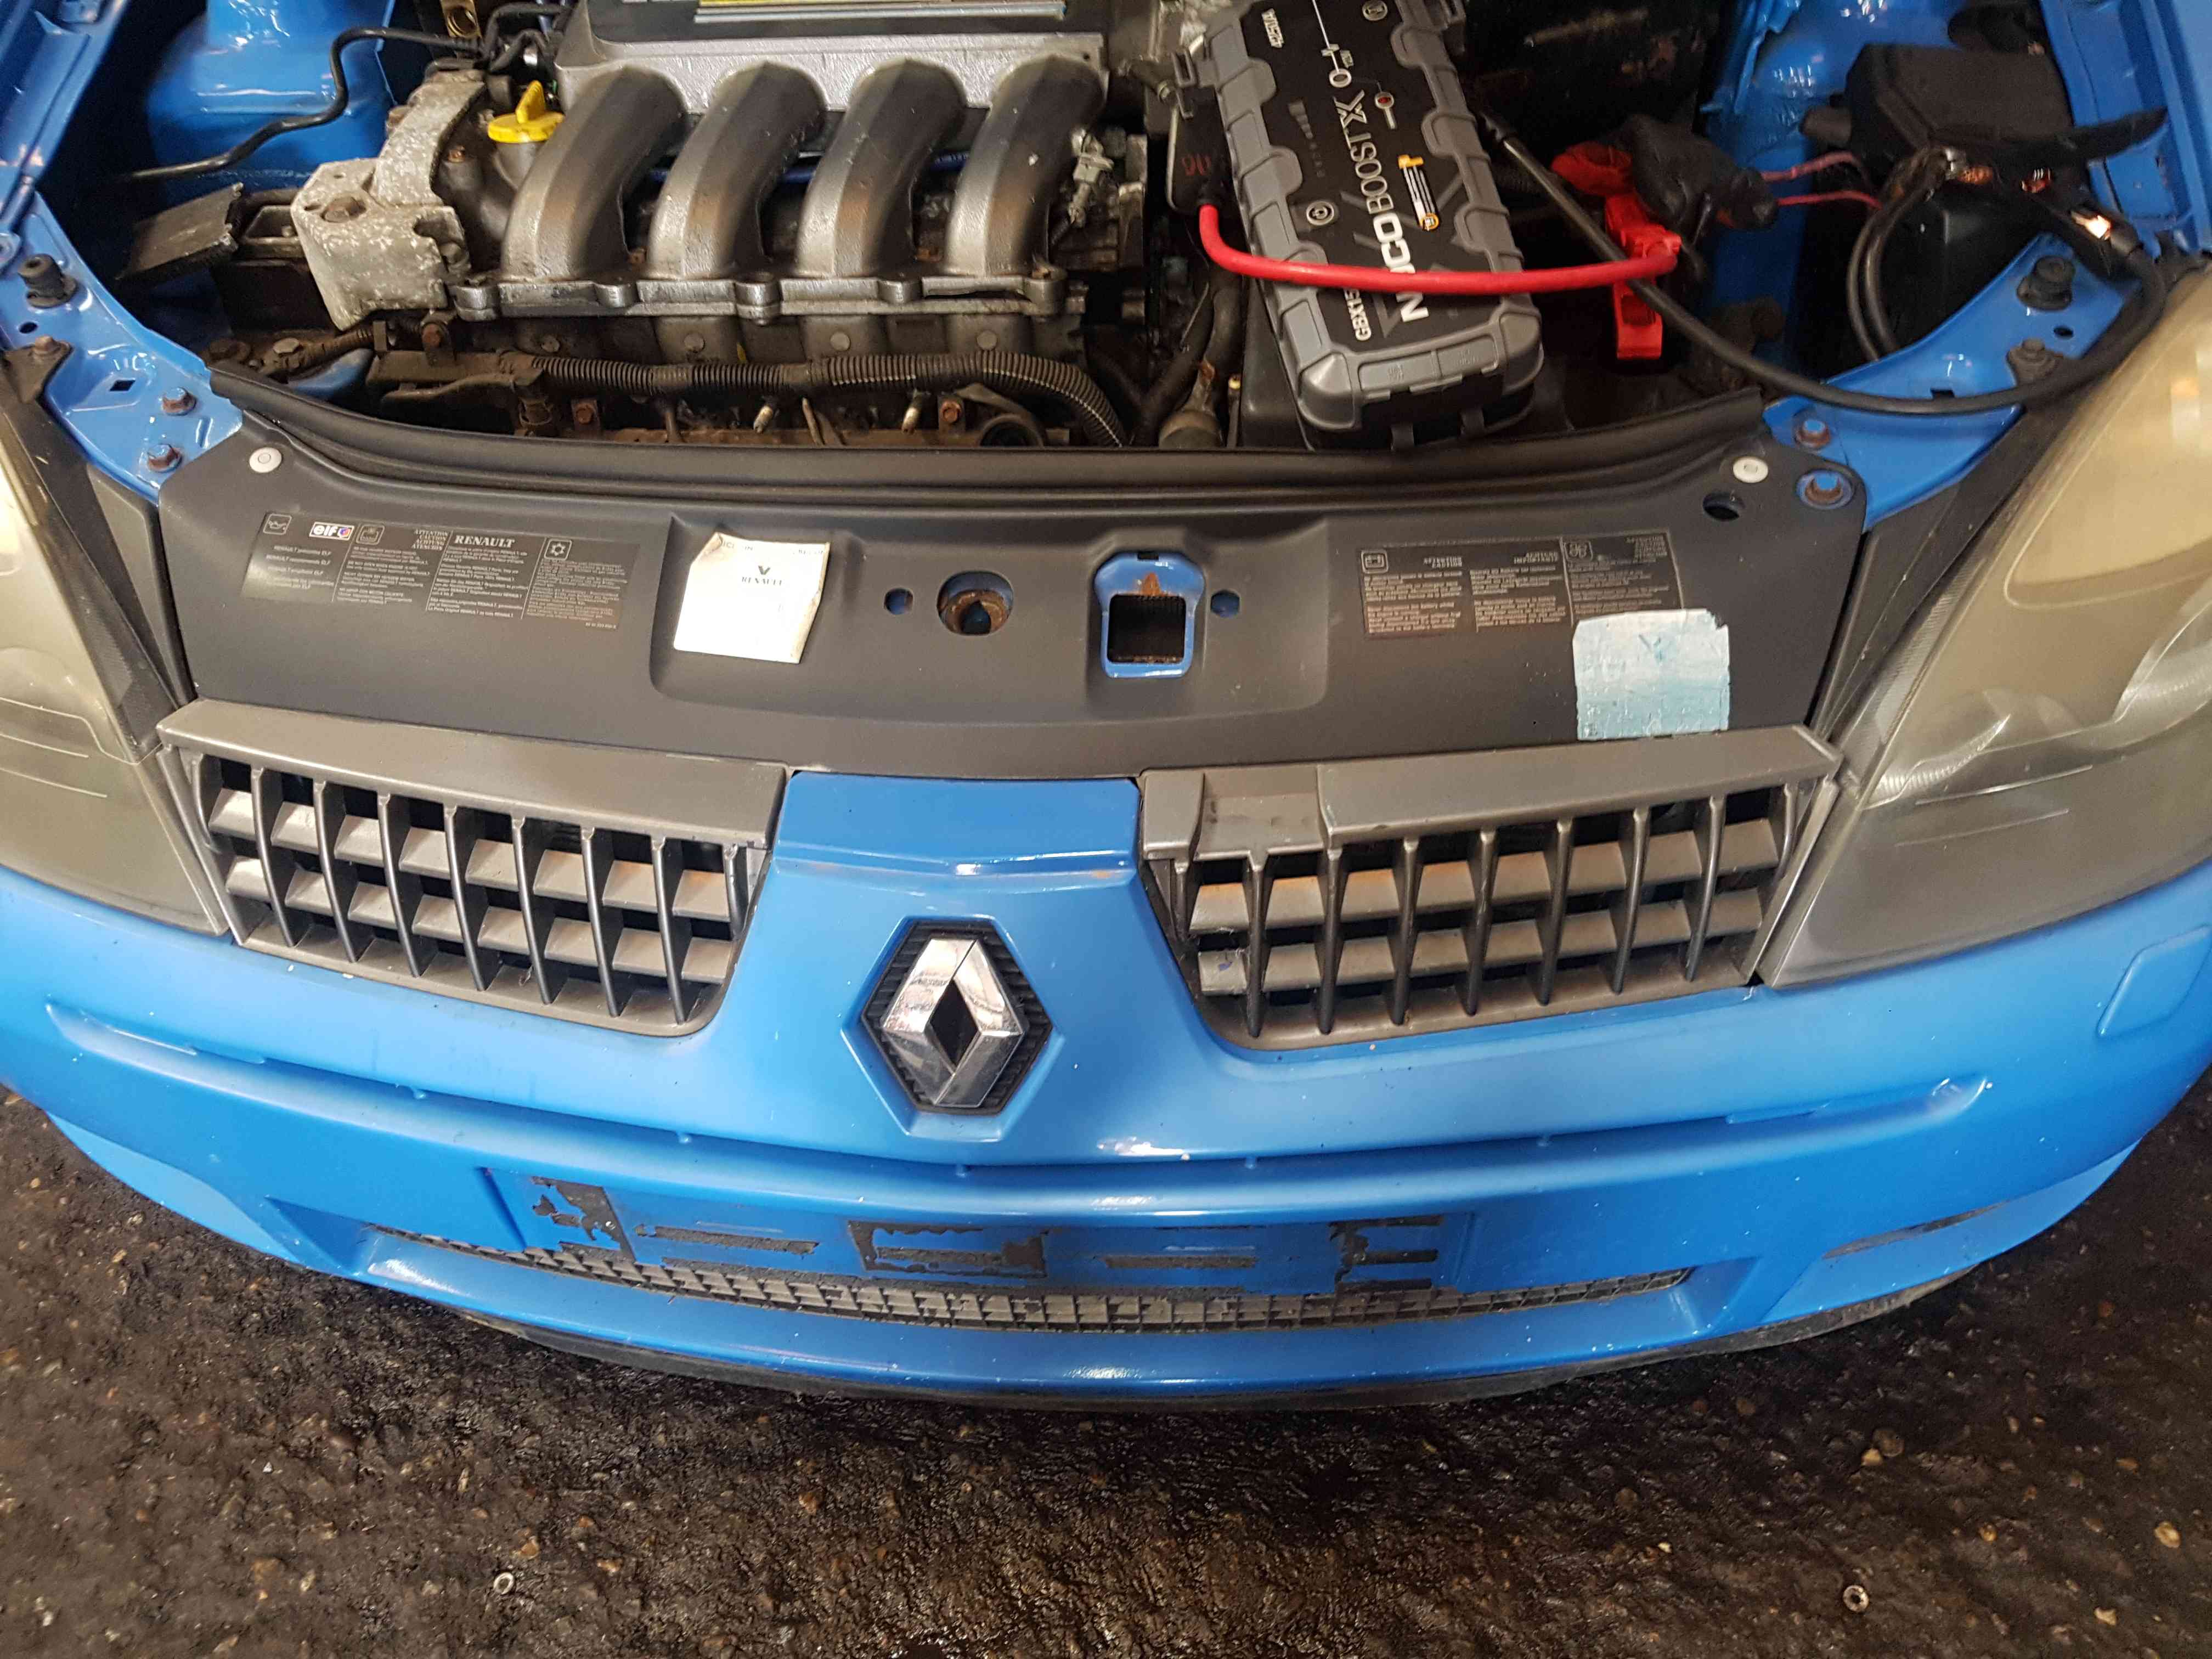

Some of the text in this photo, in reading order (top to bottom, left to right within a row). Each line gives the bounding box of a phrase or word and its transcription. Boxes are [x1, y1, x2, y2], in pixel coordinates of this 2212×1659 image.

[1373, 212, 1429, 323] NCO
[313, 525, 338, 537] elf
[455, 535, 515, 548] RENAULT
